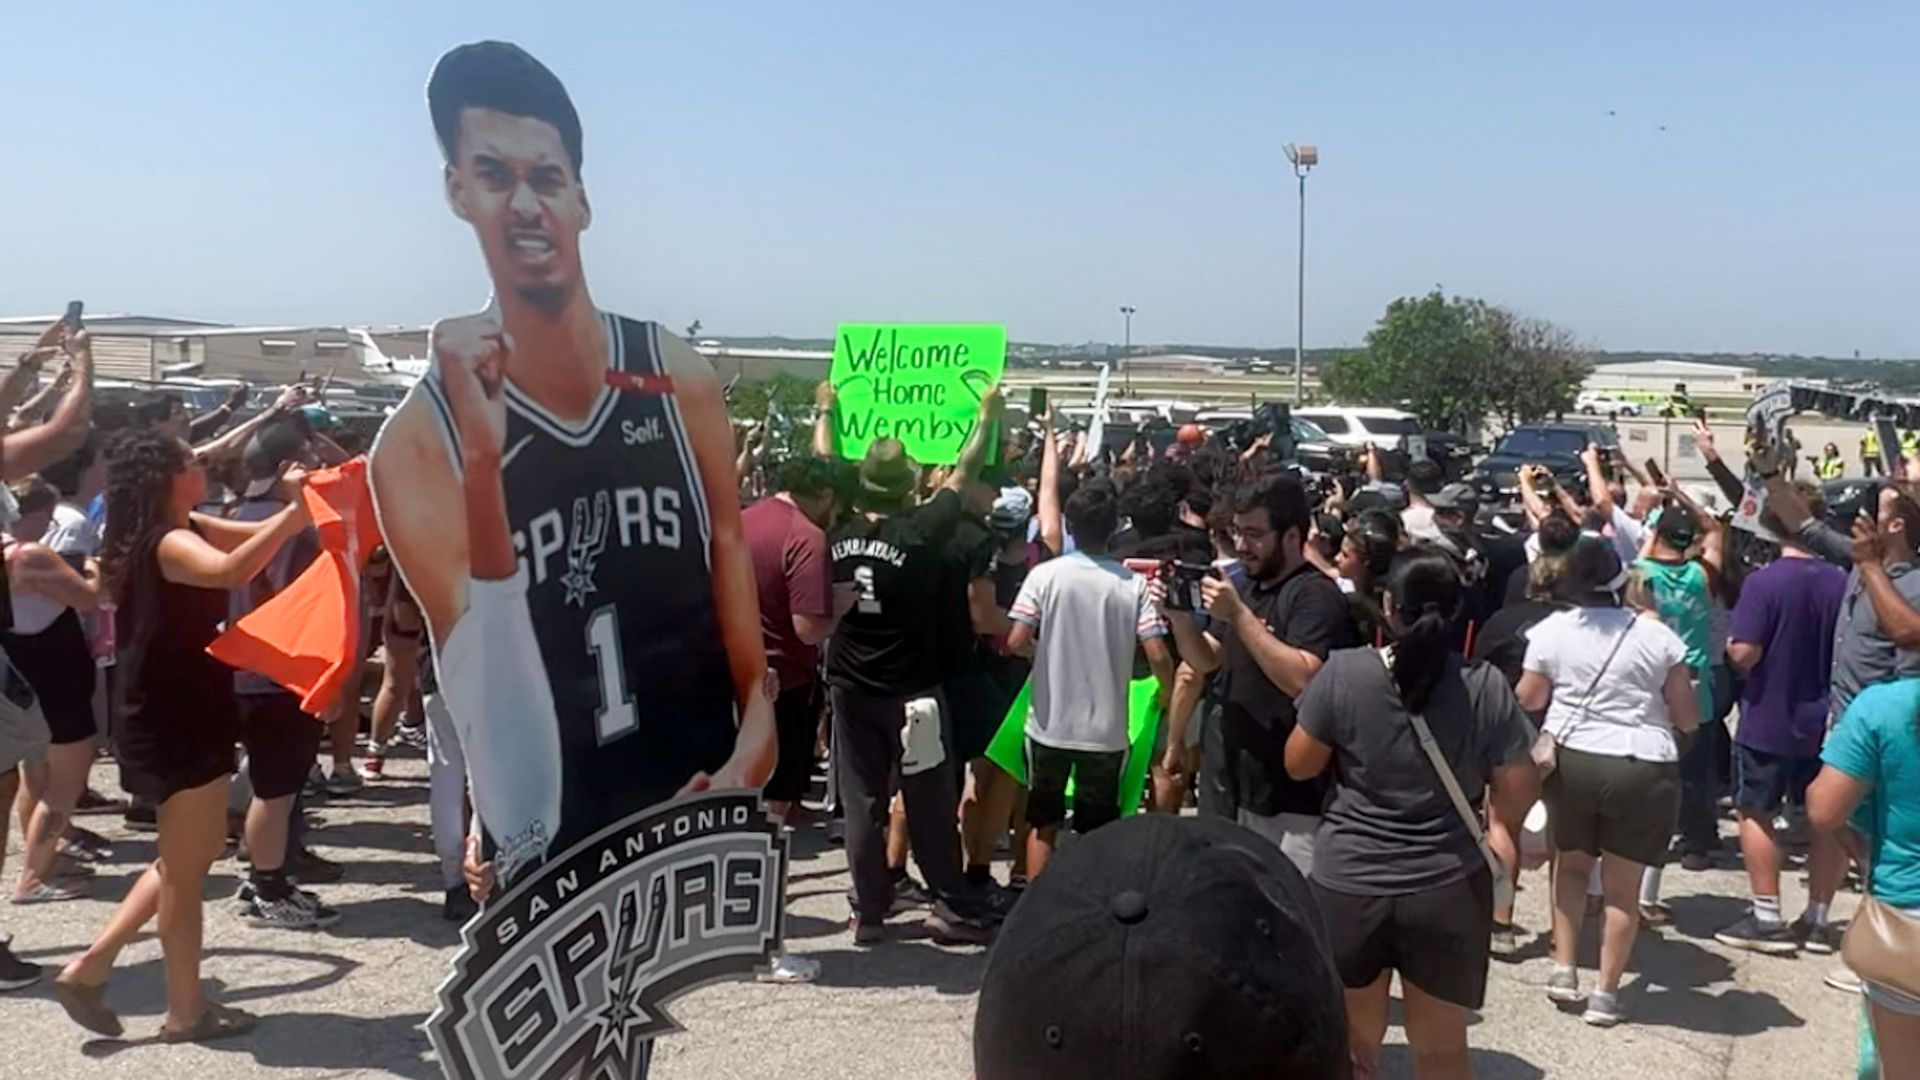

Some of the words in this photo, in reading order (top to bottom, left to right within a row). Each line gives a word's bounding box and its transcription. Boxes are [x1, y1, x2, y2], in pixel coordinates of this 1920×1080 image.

[843, 328, 969, 374] Welcome
[873, 377, 946, 406] Home
[837, 408, 974, 453] Wemby
[585, 603, 639, 747] 1
[496, 869, 579, 945] SAN
[599, 804, 748, 873] ANTONIO
[482, 852, 766, 1075] SPURS
